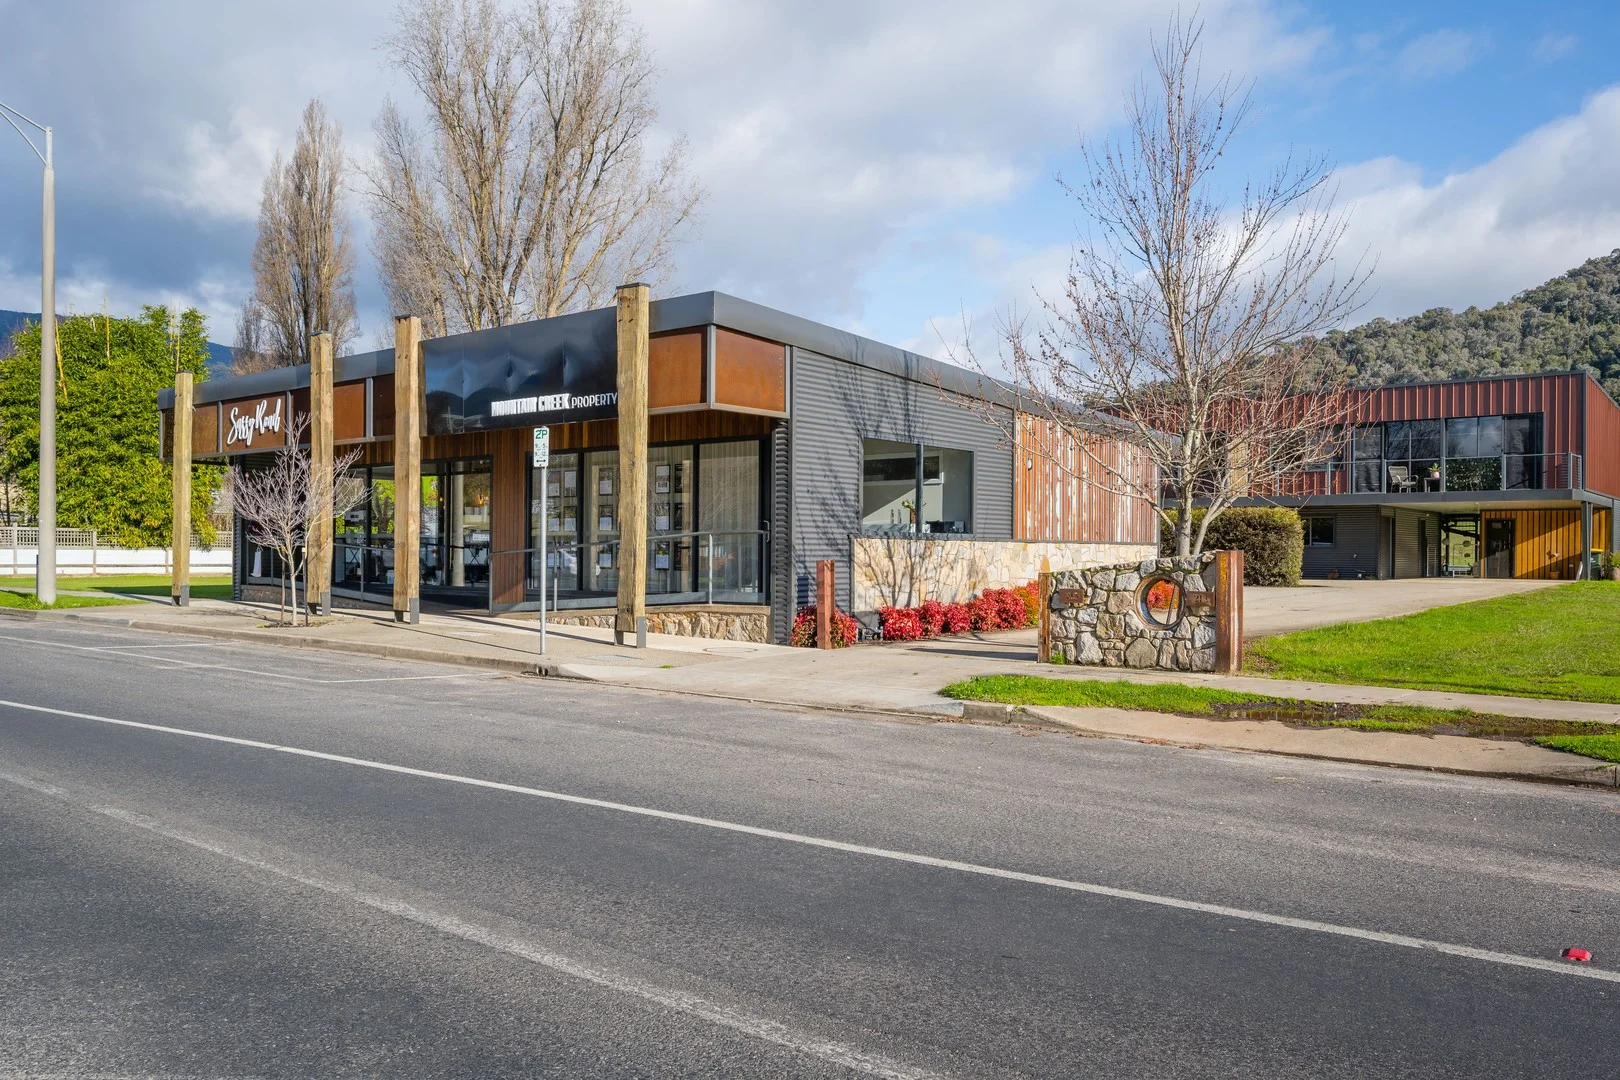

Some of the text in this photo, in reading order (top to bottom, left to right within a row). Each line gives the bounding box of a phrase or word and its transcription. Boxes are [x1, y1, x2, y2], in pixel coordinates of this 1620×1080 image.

[491, 392, 618, 417] MOUNTAIN CREEK PROPERTY
[535, 429, 548, 440] 2P
